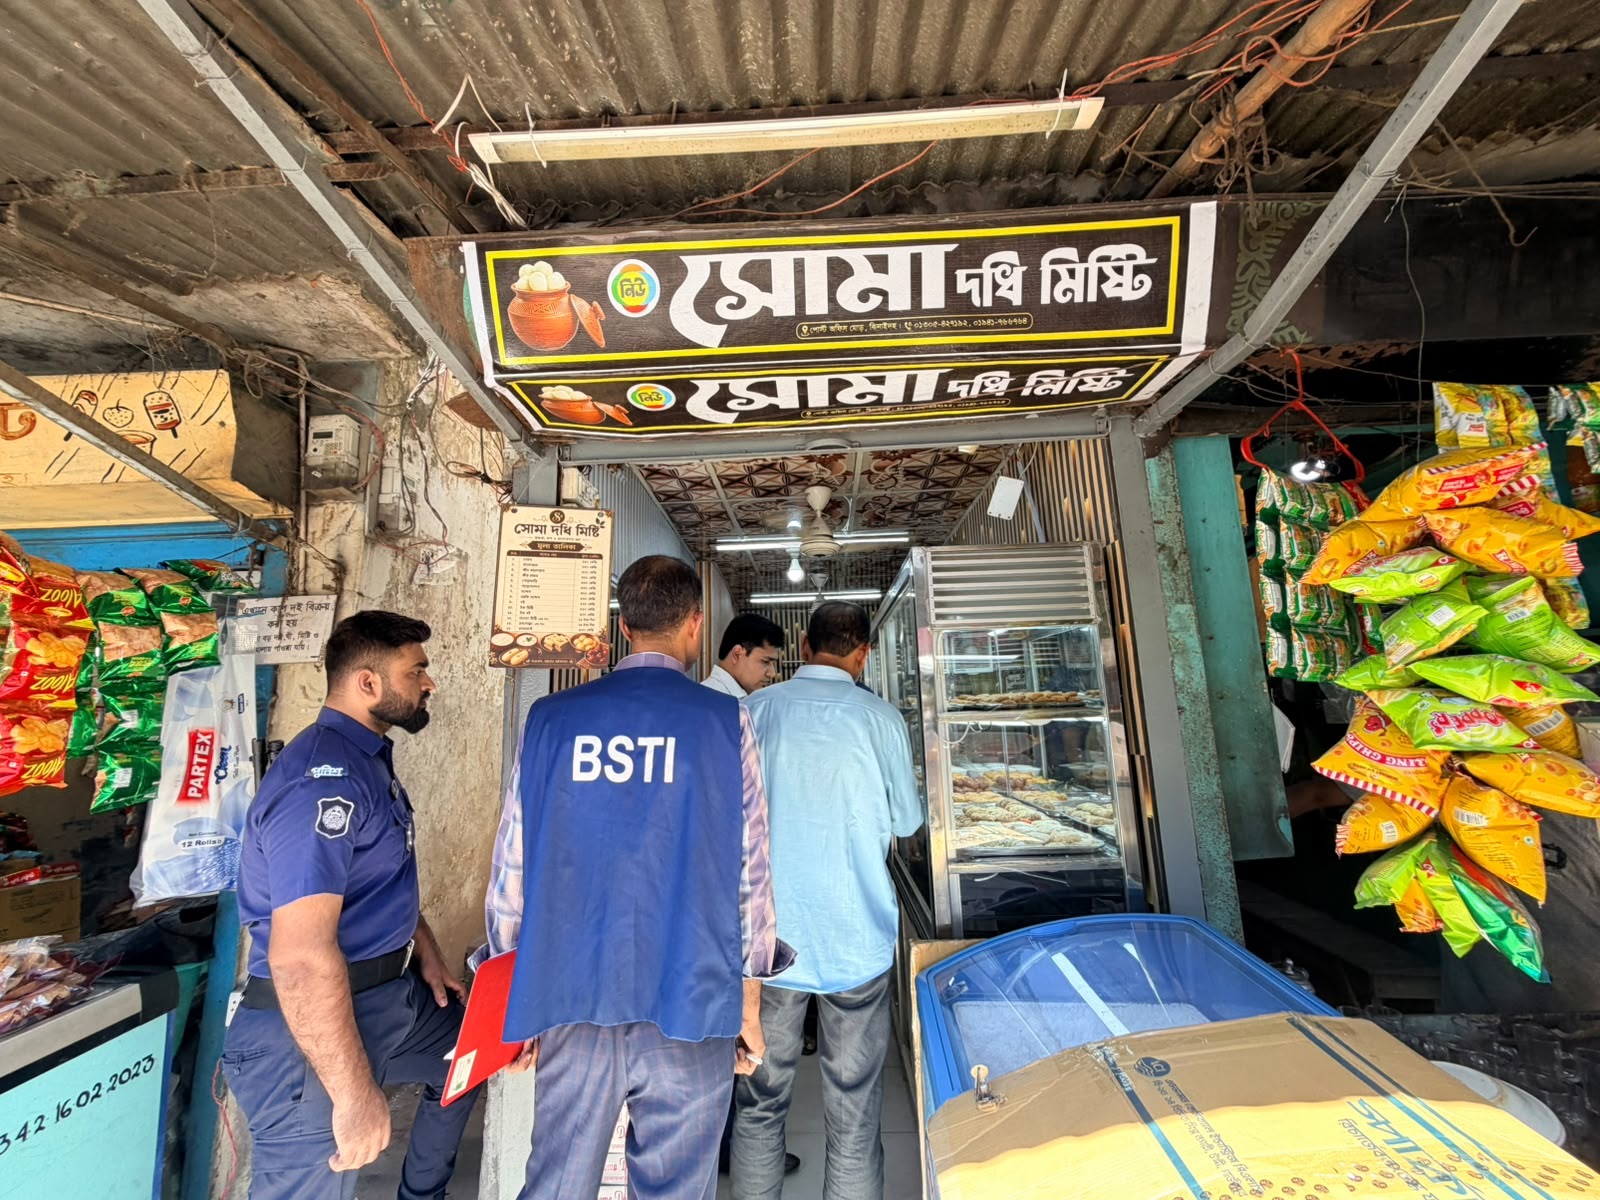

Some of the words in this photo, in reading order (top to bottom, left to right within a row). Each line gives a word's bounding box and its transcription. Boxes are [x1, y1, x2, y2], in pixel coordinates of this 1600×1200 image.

[619, 274, 648, 300] নিউ
[669, 243, 959, 348] সোমা
[955, 250, 1028, 308] দধি
[1040, 243, 1158, 305] মিষ্টি
[686, 368, 954, 424] সোমা
[947, 370, 1017, 400] দধি
[1021, 367, 1135, 396] মিষ্টি
[514, 523, 547, 534] সোমা
[550, 522, 572, 536] দধি
[575, 523, 600, 537] মিষ্টি
[186, 729, 215, 799] PARTEX
[572, 735, 676, 783] BSTI
[181, 840, 193, 849] 12
